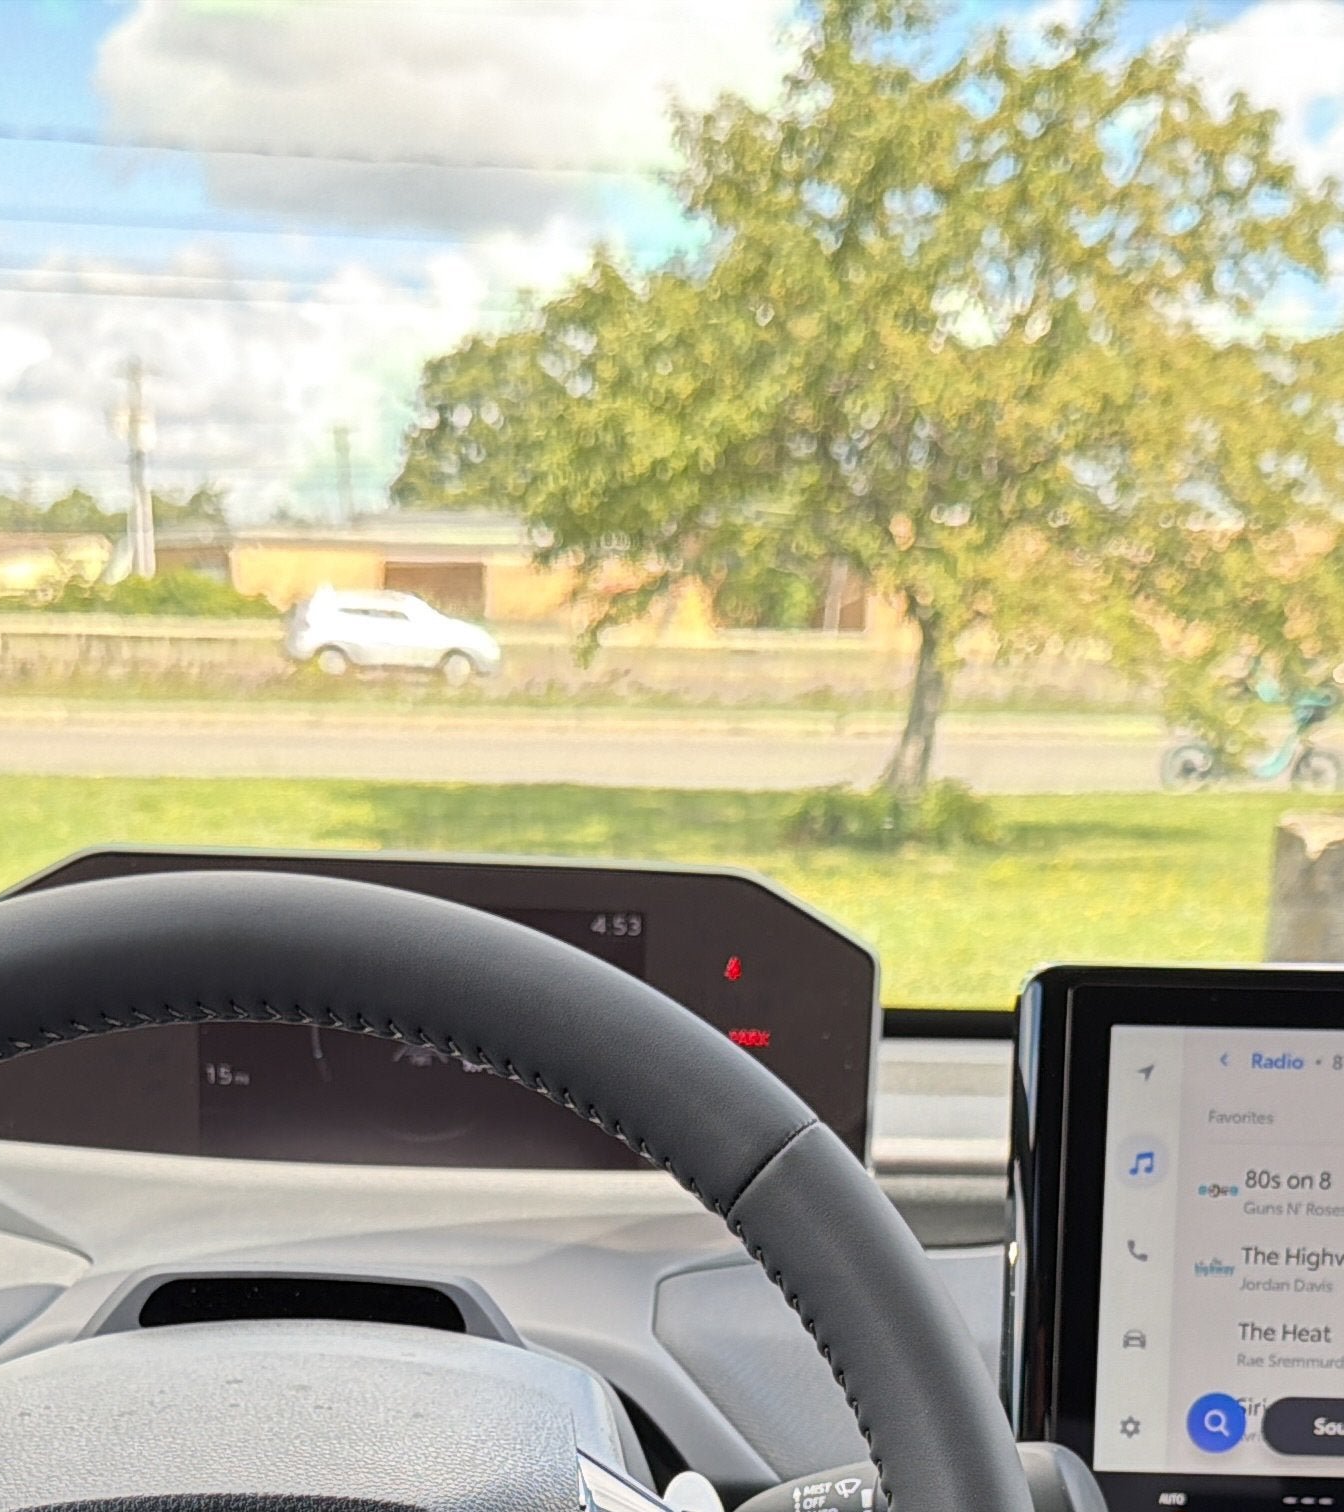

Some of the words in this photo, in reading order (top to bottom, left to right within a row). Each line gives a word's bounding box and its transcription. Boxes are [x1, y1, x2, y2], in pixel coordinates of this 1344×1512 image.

[1250, 1053, 1304, 1071] Radio
[1207, 1110, 1275, 1127] Favorites
[1244, 1169, 1281, 1190] 80s
[1286, 1174, 1314, 1190] on
[1319, 1171, 1332, 1191] 8
[1242, 1201, 1284, 1216] Guns
[1241, 1246, 1280, 1266] The
[1239, 1278, 1291, 1293] Jordan
[1294, 1279, 1334, 1294] Davis
[1237, 1321, 1274, 1342] The
[1281, 1322, 1332, 1344] Heat
[1236, 1353, 1265, 1368] Rae
[802, 1481, 834, 1497] MIST
[802, 1494, 827, 1510] OFF
[1158, 1492, 1188, 1506] AUTO
